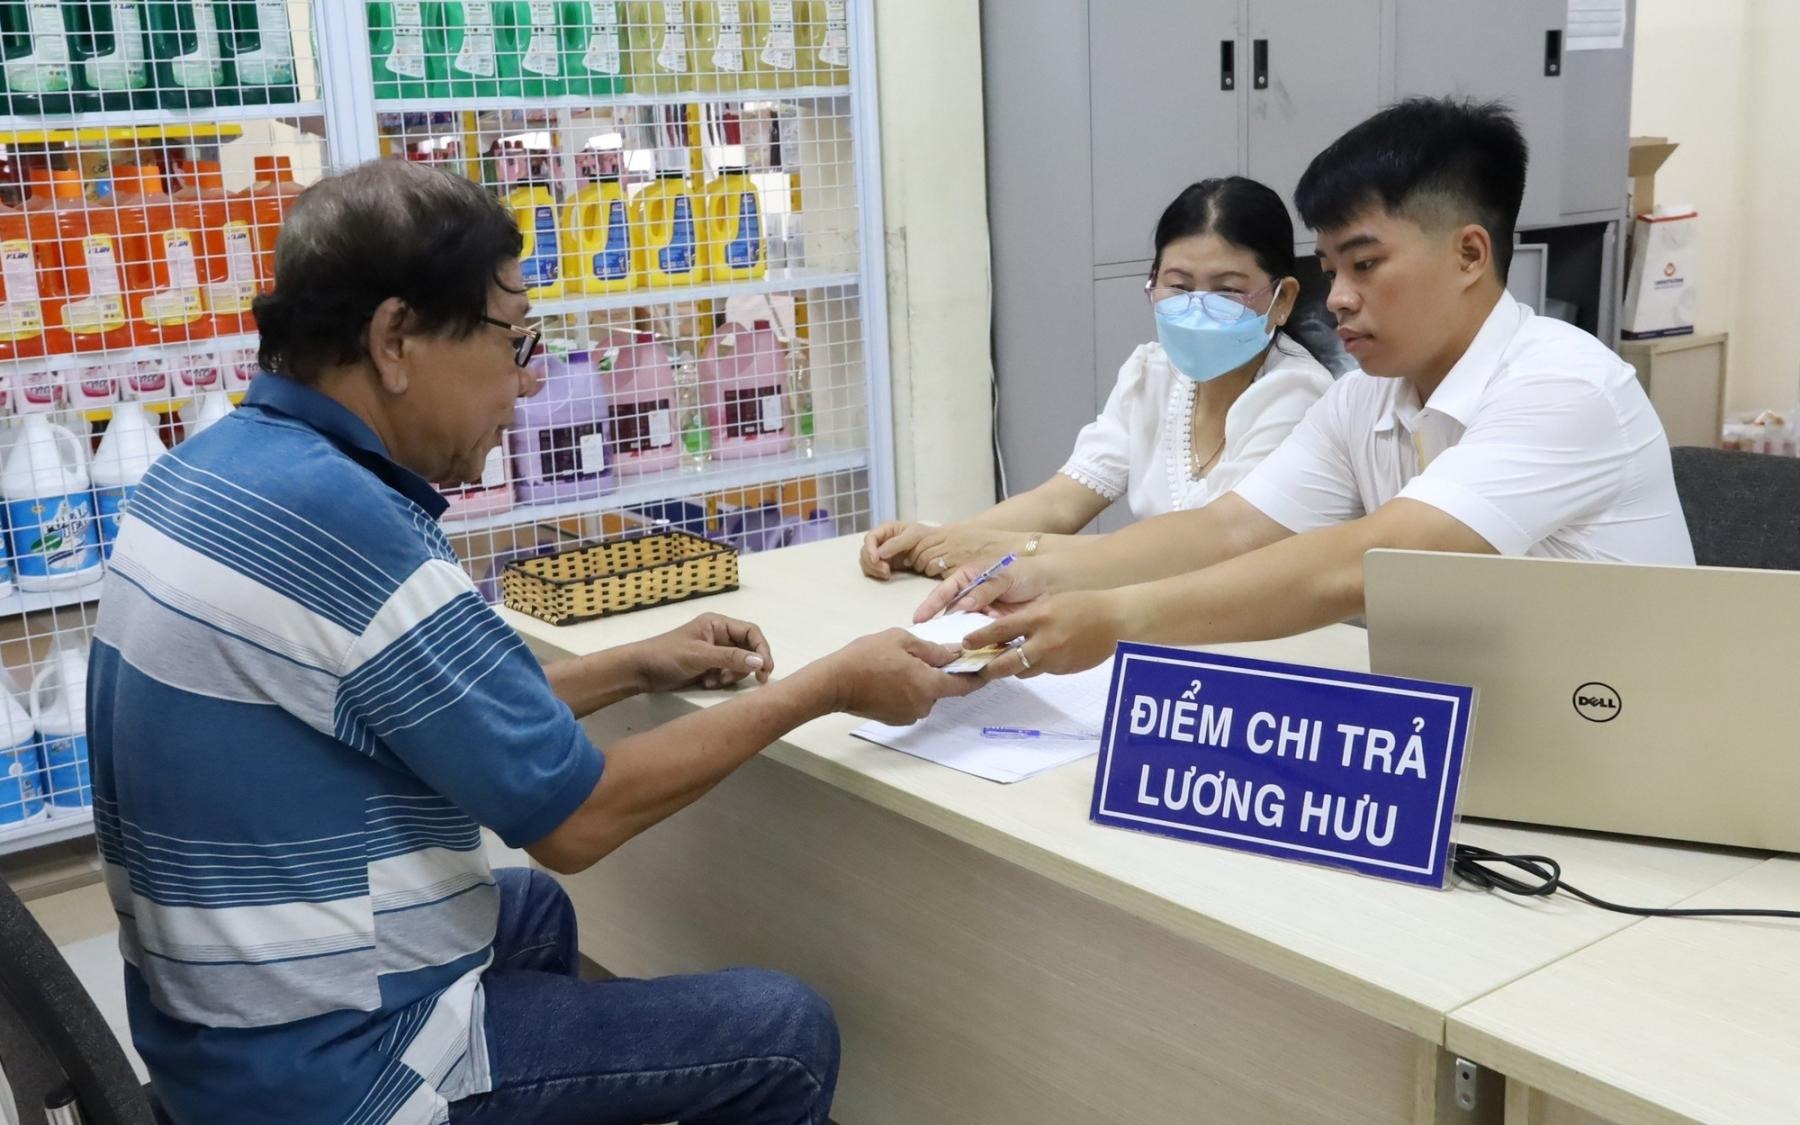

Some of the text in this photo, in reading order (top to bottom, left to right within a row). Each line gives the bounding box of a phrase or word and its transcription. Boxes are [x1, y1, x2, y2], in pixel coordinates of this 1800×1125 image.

[1129, 679, 1427, 779] ĐIỂM CHI TRẢ
[1578, 695, 1616, 709] DELL
[1137, 764, 1398, 847] LƯƠNG HƯU
